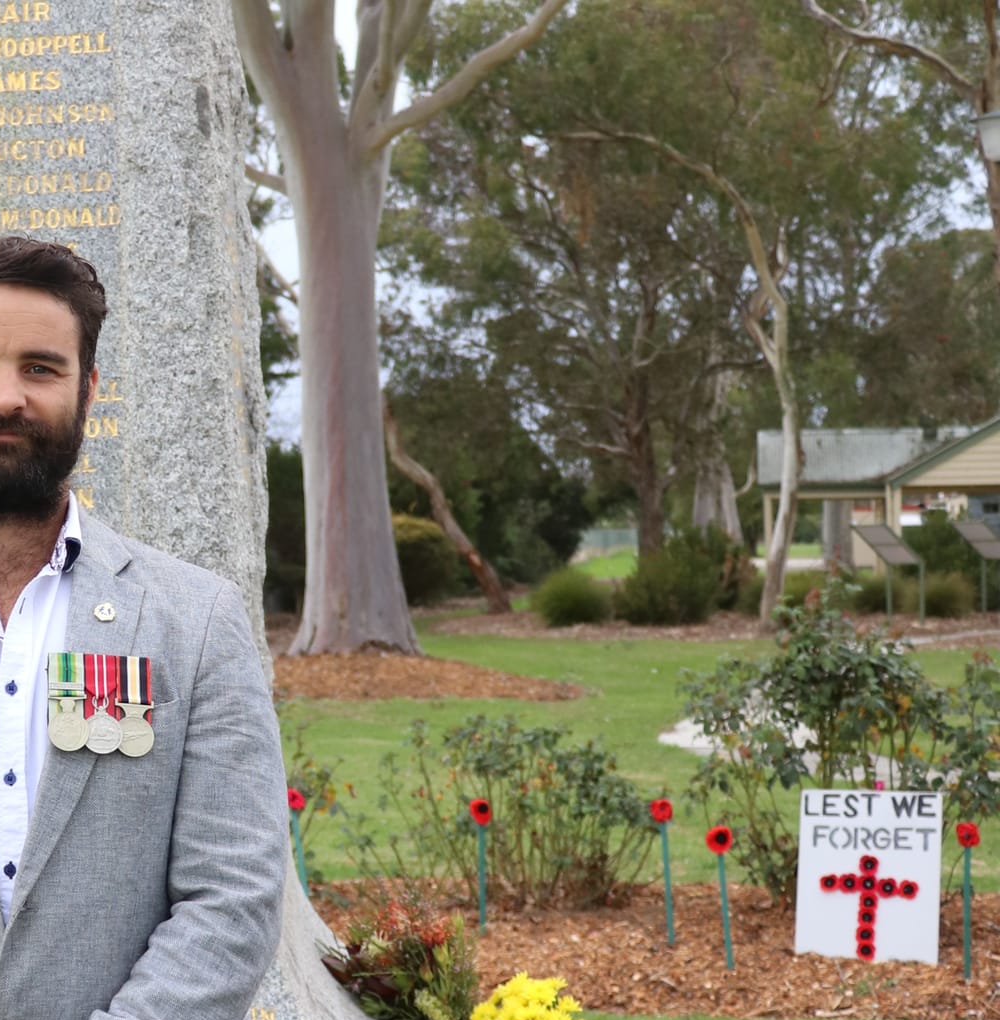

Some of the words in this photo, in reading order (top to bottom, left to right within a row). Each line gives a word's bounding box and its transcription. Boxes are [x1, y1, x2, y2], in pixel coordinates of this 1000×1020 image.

[804, 794, 881, 818] LEST
[891, 794, 937, 818] WE
[812, 825, 937, 852] FORGET
